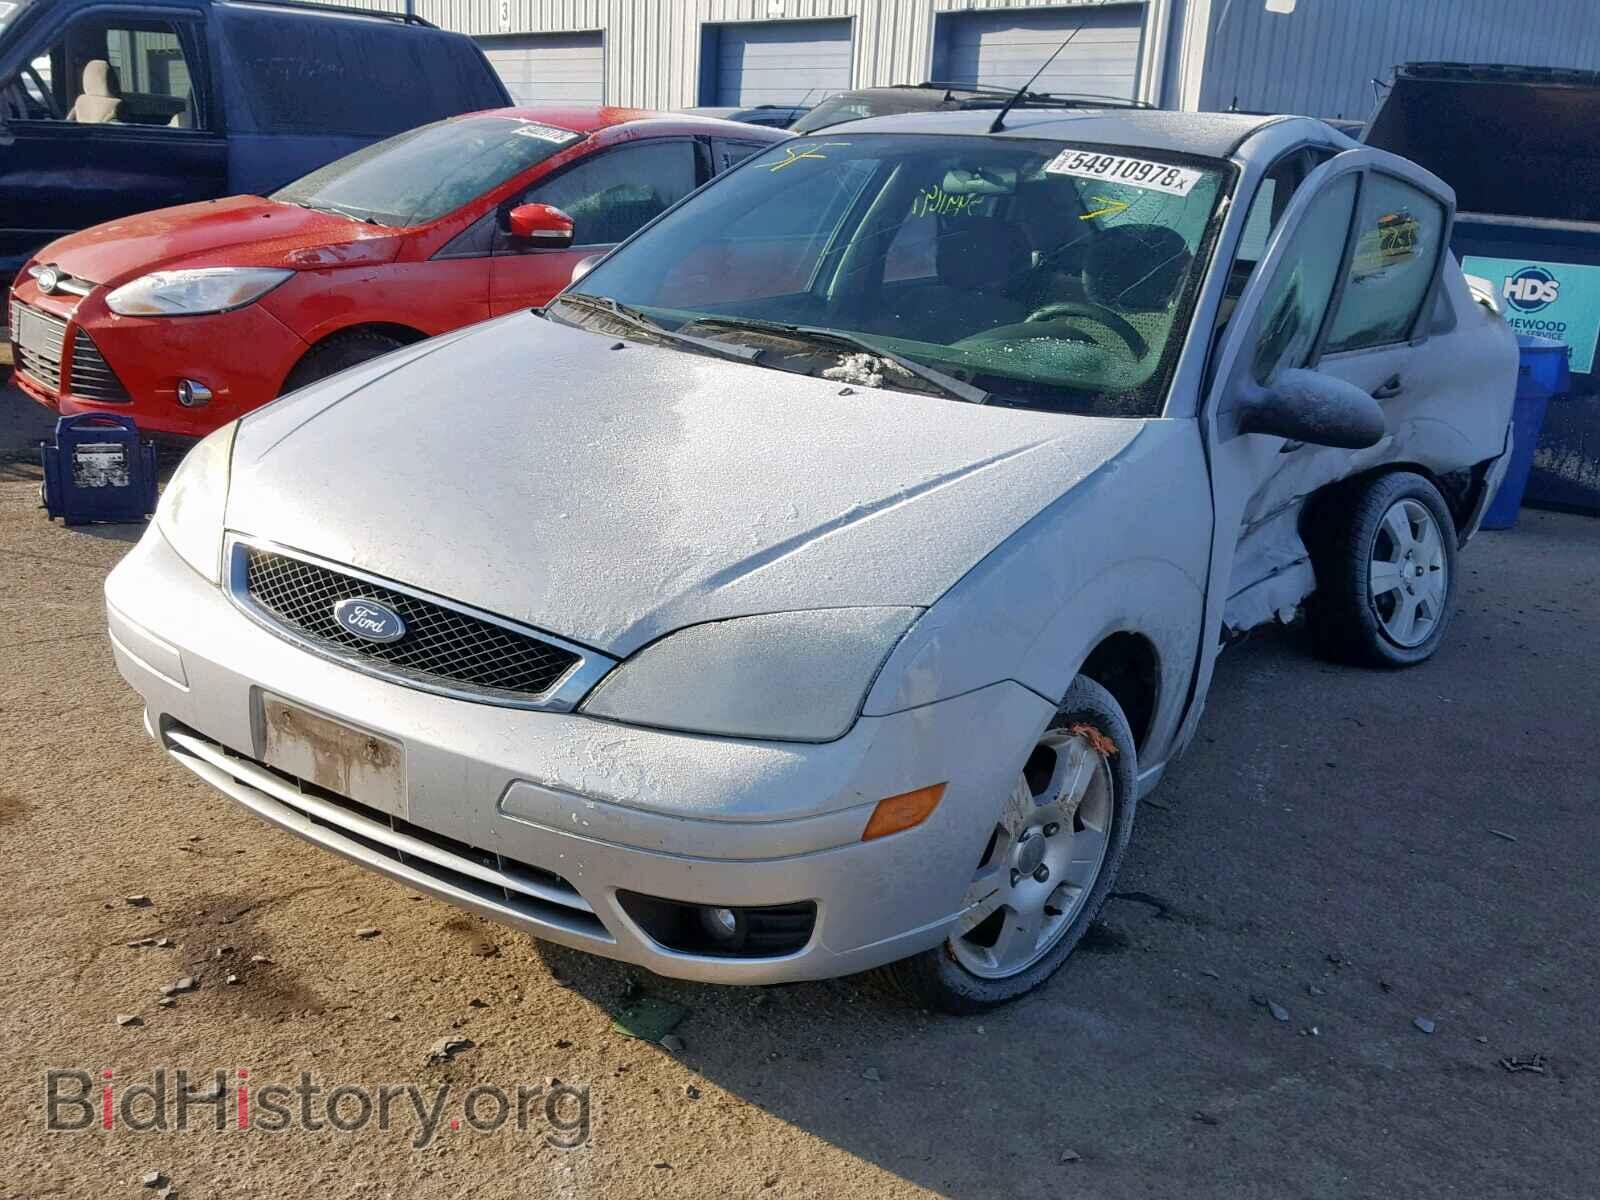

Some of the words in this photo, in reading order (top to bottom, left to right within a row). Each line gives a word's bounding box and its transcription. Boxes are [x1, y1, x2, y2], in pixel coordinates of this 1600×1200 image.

[502, 1, 509, 21] 3
[1503, 275, 1560, 303] HDS
[348, 605, 386, 633] Ford
